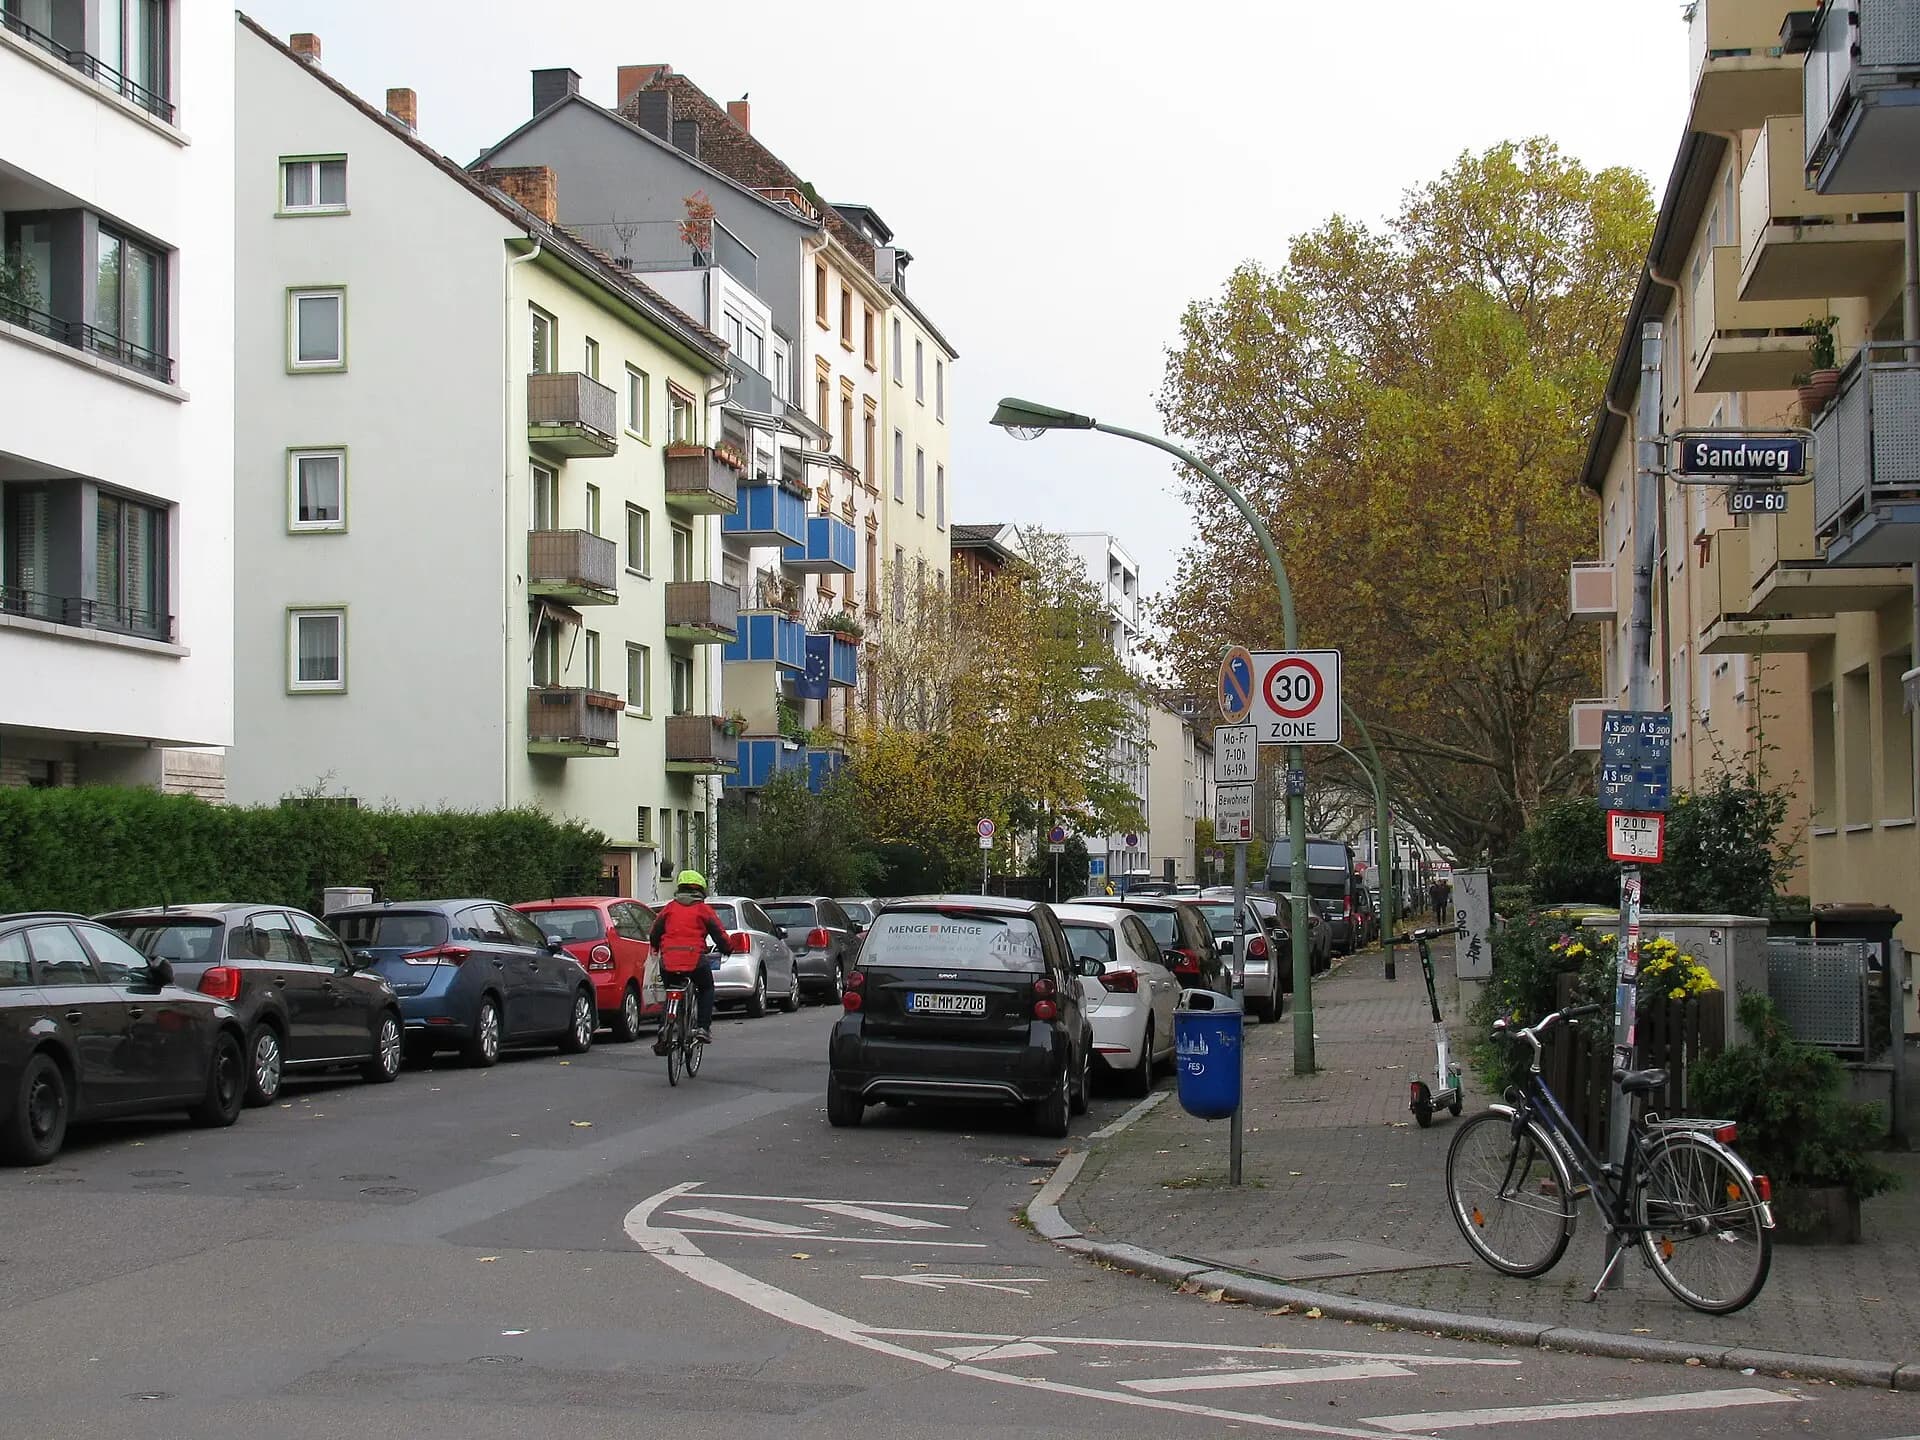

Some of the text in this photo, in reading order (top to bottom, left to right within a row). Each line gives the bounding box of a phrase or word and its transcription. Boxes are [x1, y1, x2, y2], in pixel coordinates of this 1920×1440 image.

[1696, 443, 1789, 471] Sandweg
[1734, 494, 1785, 509] 80-60
[1276, 674, 1310, 702] 30
[1271, 722, 1316, 737] ZONE
[1620, 725, 1635, 733] 200
[1656, 726, 1671, 735] 200
[1223, 732, 1248, 745] Mo-Fr
[1620, 774, 1633, 783] 150
[1218, 794, 1250, 806] Bewohner
[1613, 797, 1624, 806] 25
[888, 925, 982, 936] MENGE MENGE
[915, 995, 930, 1008] GG
[955, 997, 984, 1010] 2708
[1188, 1062, 1201, 1071] FES
